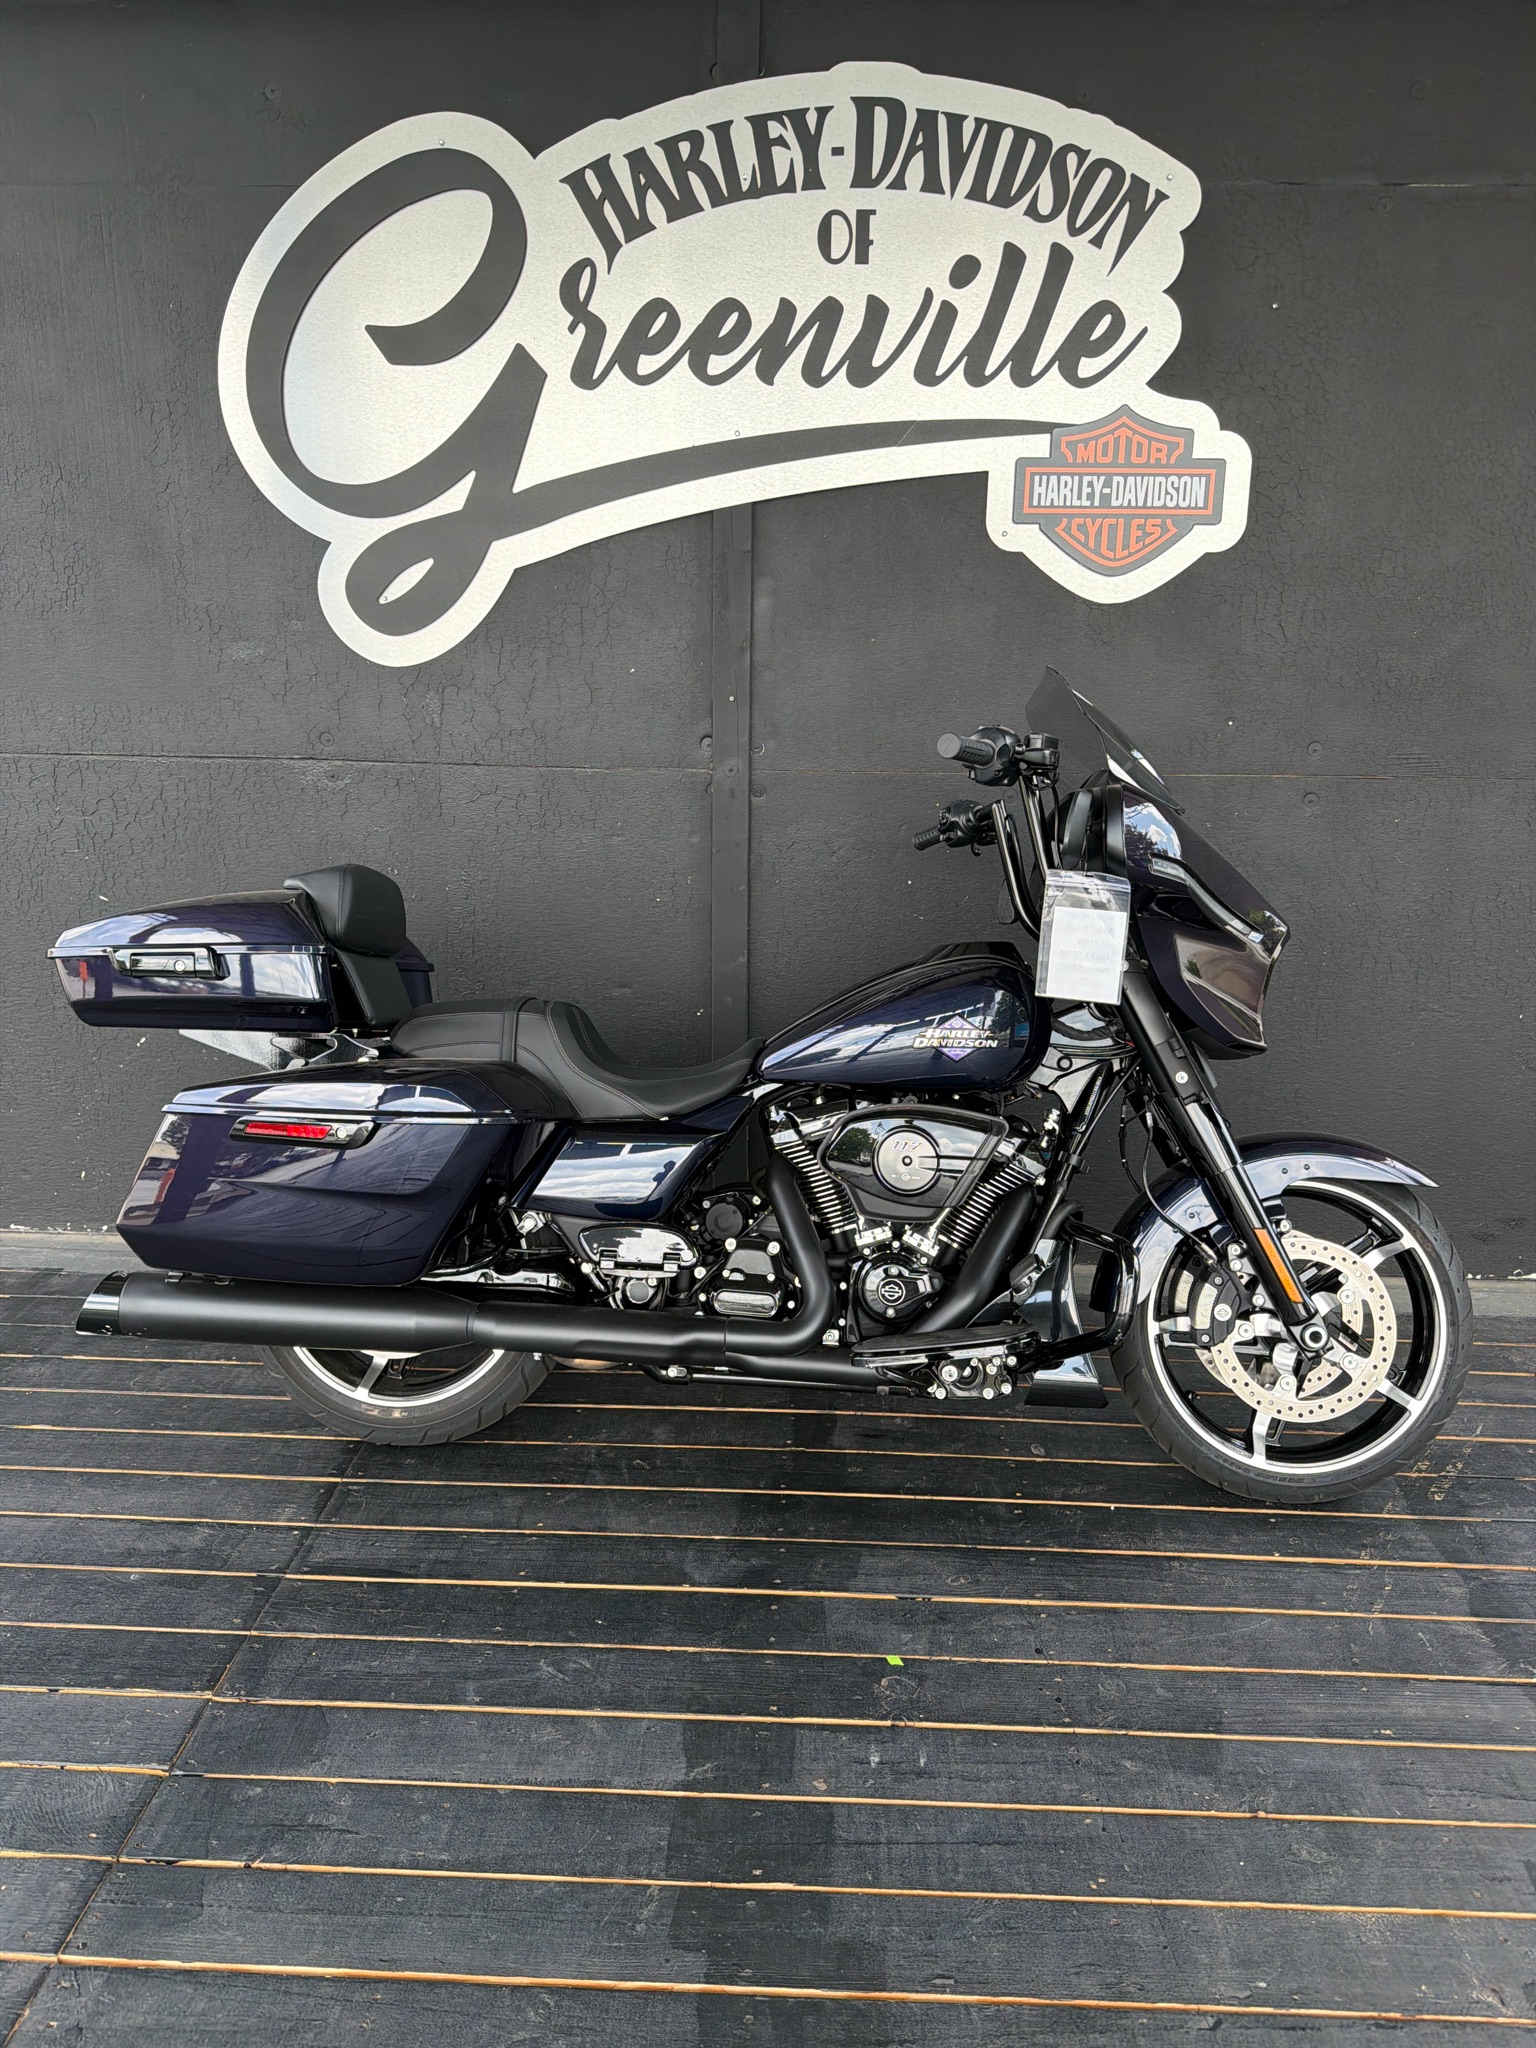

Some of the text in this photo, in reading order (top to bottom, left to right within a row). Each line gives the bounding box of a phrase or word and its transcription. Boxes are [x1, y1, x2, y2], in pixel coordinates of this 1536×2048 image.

[558, 95, 1171, 276] HARLEY-DAVIDSON
[817, 208, 877, 266] OF
[246, 147, 1149, 637] Greenville
[1076, 426, 1168, 464] MOTOR
[1032, 475, 1206, 508] HARLEY-DAVIDSON
[1071, 518, 1161, 559] CYCLES
[913, 1038, 999, 1048] DAVIDSON
[892, 1140, 923, 1152] 117
